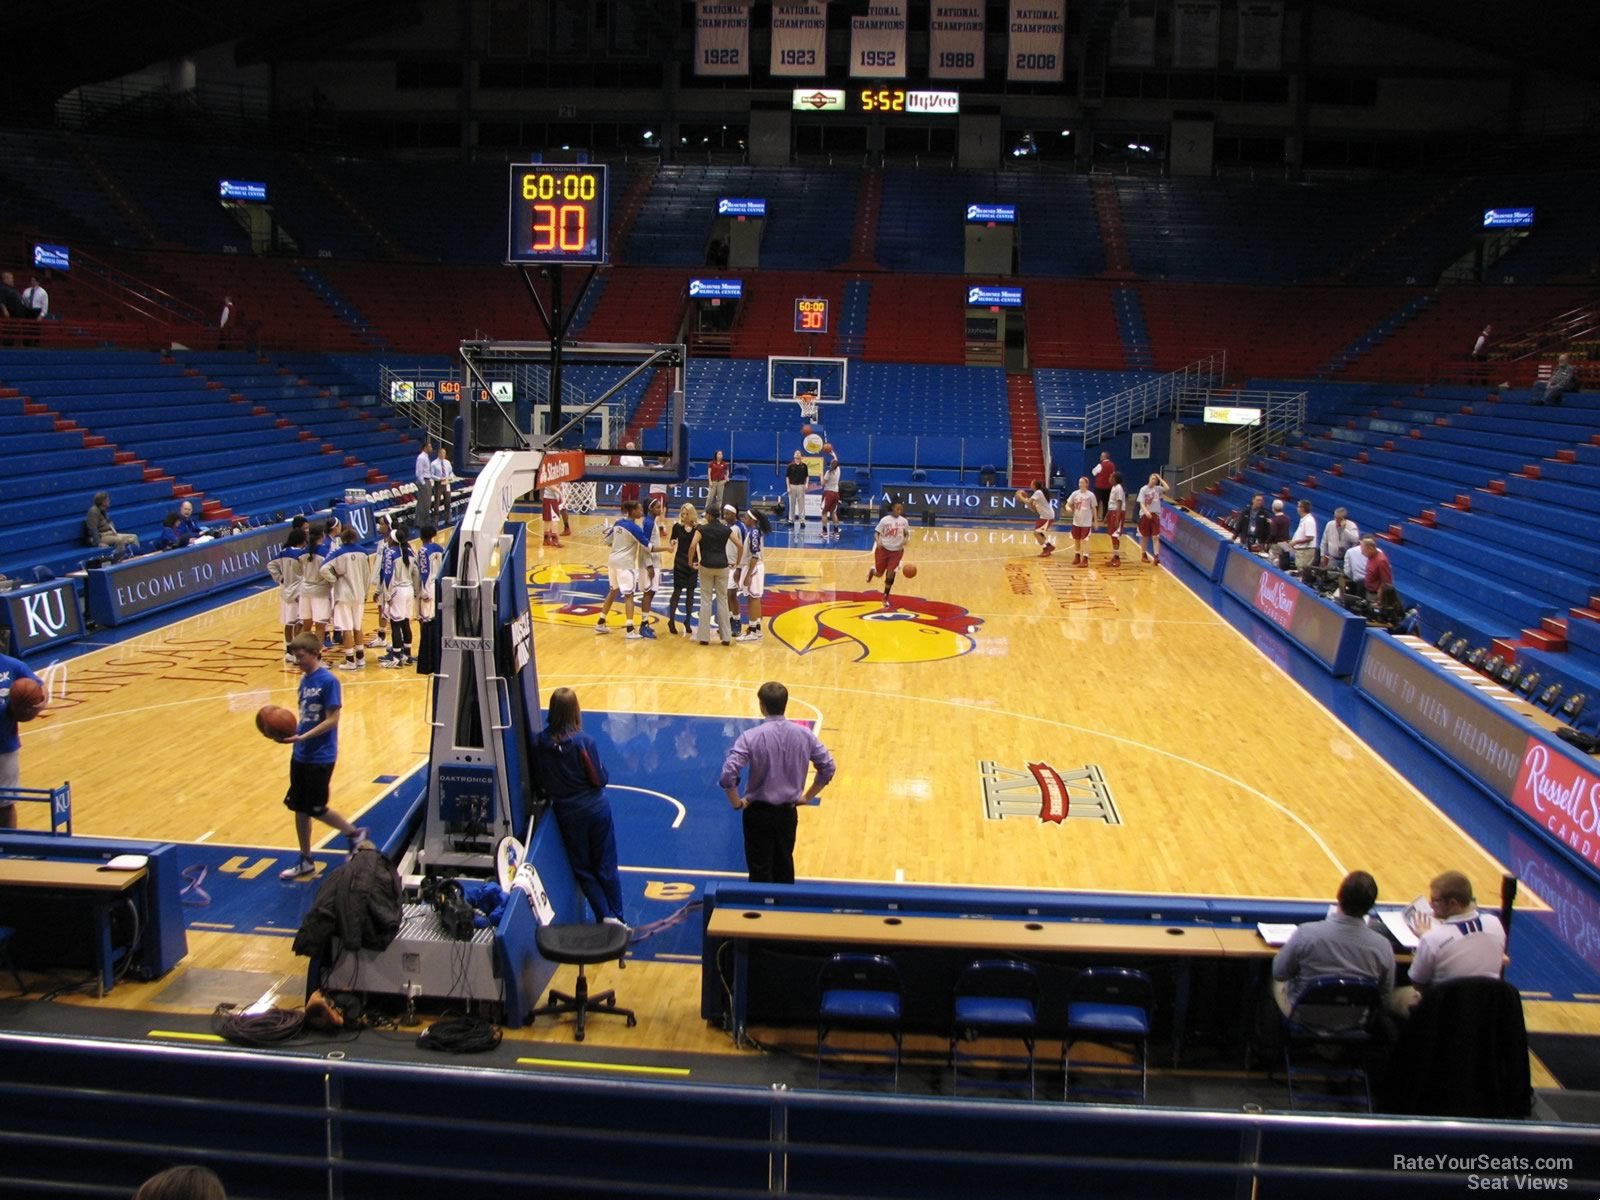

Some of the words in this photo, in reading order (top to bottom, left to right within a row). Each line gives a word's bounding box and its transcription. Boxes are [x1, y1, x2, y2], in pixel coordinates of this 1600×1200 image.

[702, 5, 743, 15] NATIONAL
[778, 5, 821, 15] NATIONAL
[868, 6, 901, 16] TIONAL
[937, 7, 980, 18] NATIONAL
[1016, 9, 1059, 20] NATIONAL
[697, 19, 747, 29] CHAMPIONS
[774, 19, 825, 29] CHAMPIONS
[853, 20, 905, 30] CHAMPIONS
[932, 21, 984, 31] CHAMPIONS
[1011, 23, 1064, 34] CHAMPIONS
[704, 49, 739, 65] 1922
[780, 50, 816, 65] 1923
[860, 51, 896, 66] 1952
[940, 53, 975, 68] 1988
[1016, 54, 1056, 69] 2008
[861, 90, 905, 111] 5:52
[523, 174, 595, 200] 60:00
[533, 205, 585, 250] 30
[799, 302, 825, 312] 60:00
[802, 312, 821, 328] 30
[440, 382, 460, 393] 60:0
[426, 390, 432, 400] 0
[480, 390, 488, 400] 0
[881, 493, 916, 505] AL
[924, 494, 980, 507] WHO
[990, 495, 1058, 509] ENR
[349, 507, 368, 539] KU
[117, 570, 186, 607] ELCOME
[192, 563, 213, 583] TO
[221, 549, 260, 574] ALLEN
[21, 587, 67, 638] KU
[444, 639, 491, 649] KANSAS
[1400, 679, 1416, 704] TO
[1419, 693, 1449, 729] ALLEN
[1453, 716, 1520, 779] FIELDHOU
[439, 775, 493, 784] DAKTRONICS
[1525, 744, 1587, 824] Russell
[55, 790, 70, 814] KU
